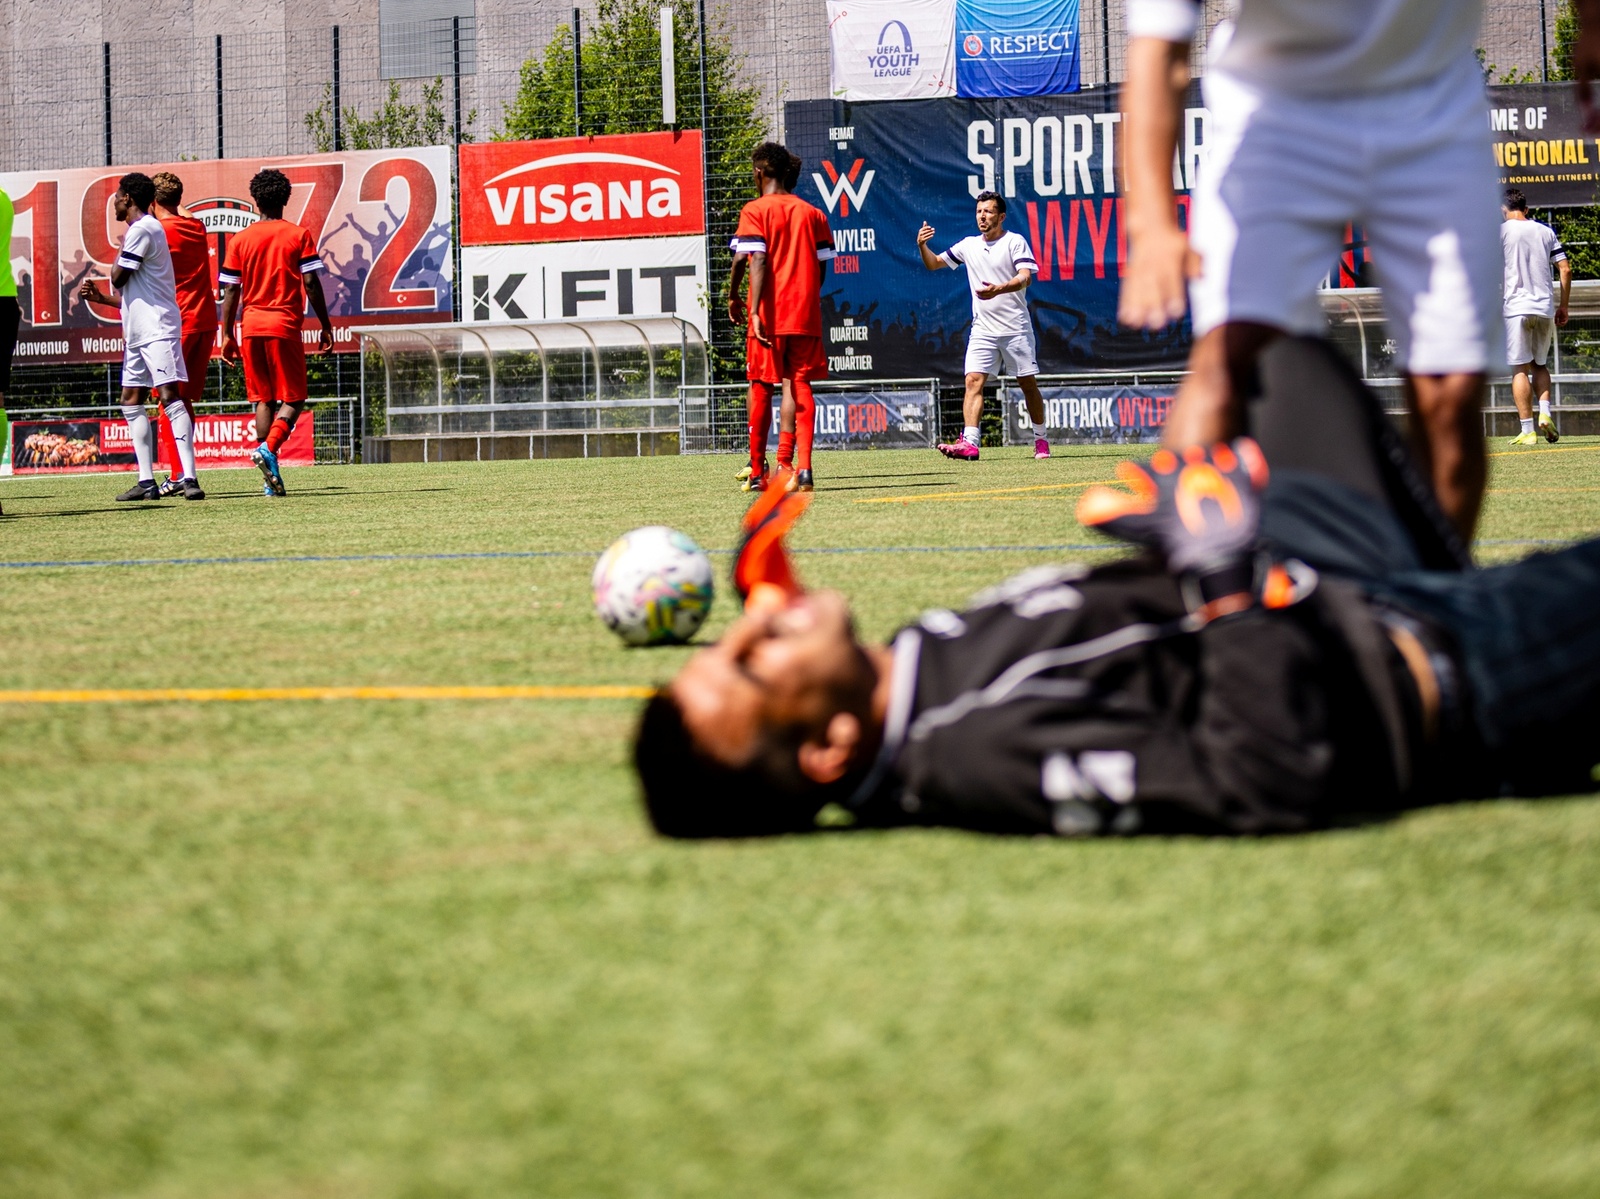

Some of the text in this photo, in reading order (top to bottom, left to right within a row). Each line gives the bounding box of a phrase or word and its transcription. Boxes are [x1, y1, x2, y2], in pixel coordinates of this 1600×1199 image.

[877, 45, 900, 55] UEFA
[990, 31, 1073, 55] RESPECT
[867, 54, 920, 69] YOUTH
[874, 67, 911, 78] LEAGUE
[1524, 106, 1547, 130] OF
[829, 126, 855, 141] HEIMAT
[1509, 174, 1555, 184] NORMALES
[1557, 172, 1592, 182] FITNESS
[833, 228, 876, 253] WYLER
[833, 255, 860, 275] BERN
[472, 264, 696, 321] K FIT
[830, 326, 868, 344] QUARTIER
[13, 339, 70, 357] ienvenue
[827, 354, 873, 373] Z'QUARTIER
[847, 402, 888, 433] BERN
[1018, 397, 1115, 430] SORTPARK
